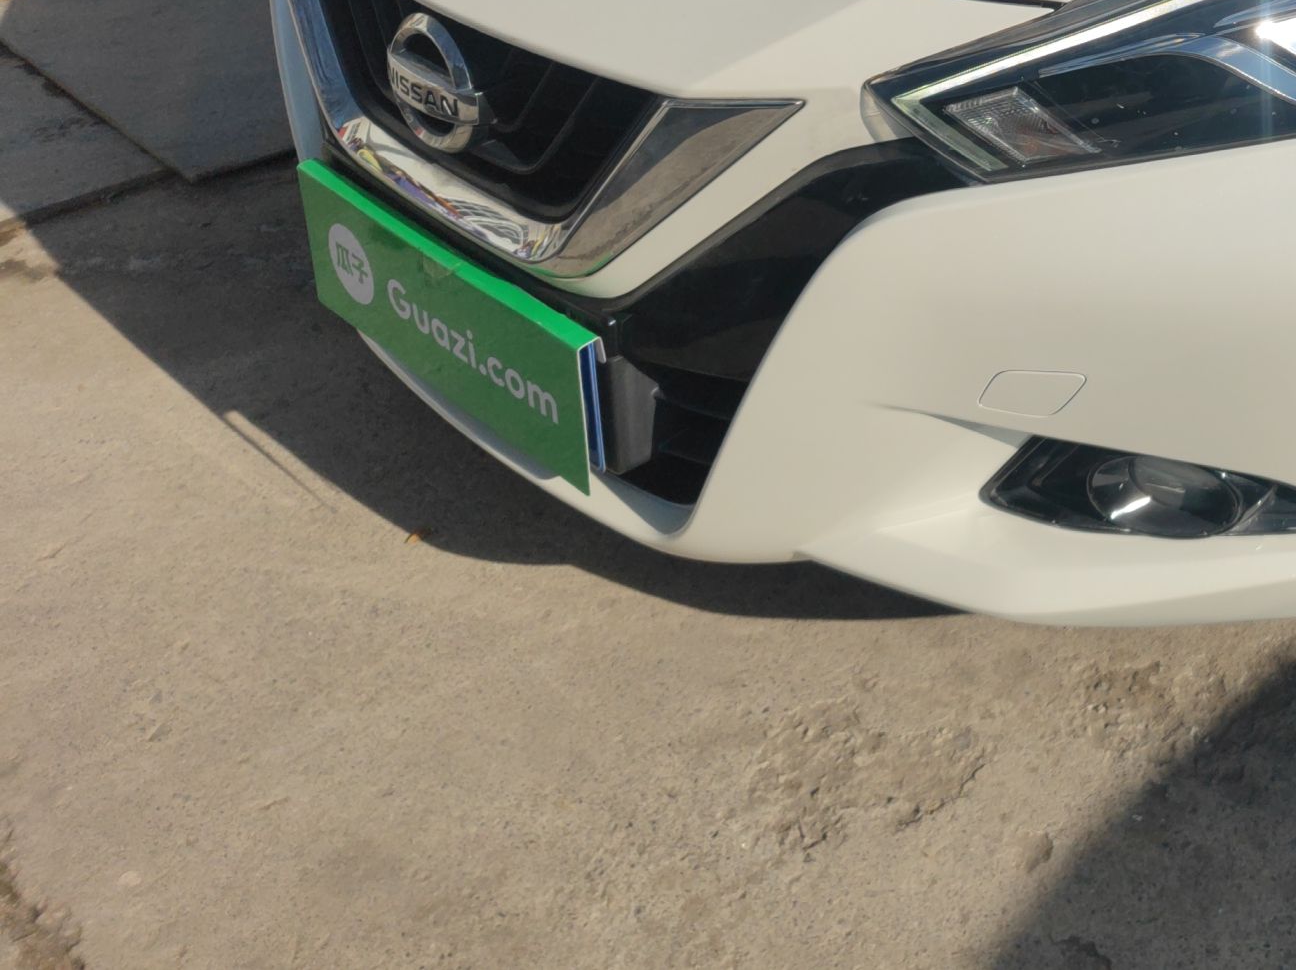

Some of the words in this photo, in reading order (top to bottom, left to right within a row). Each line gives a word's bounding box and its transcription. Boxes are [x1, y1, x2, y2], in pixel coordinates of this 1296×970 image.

[388, 62, 459, 117] NISSAN
[335, 241, 369, 285] 瓜子
[387, 278, 559, 425] Guazi.com
